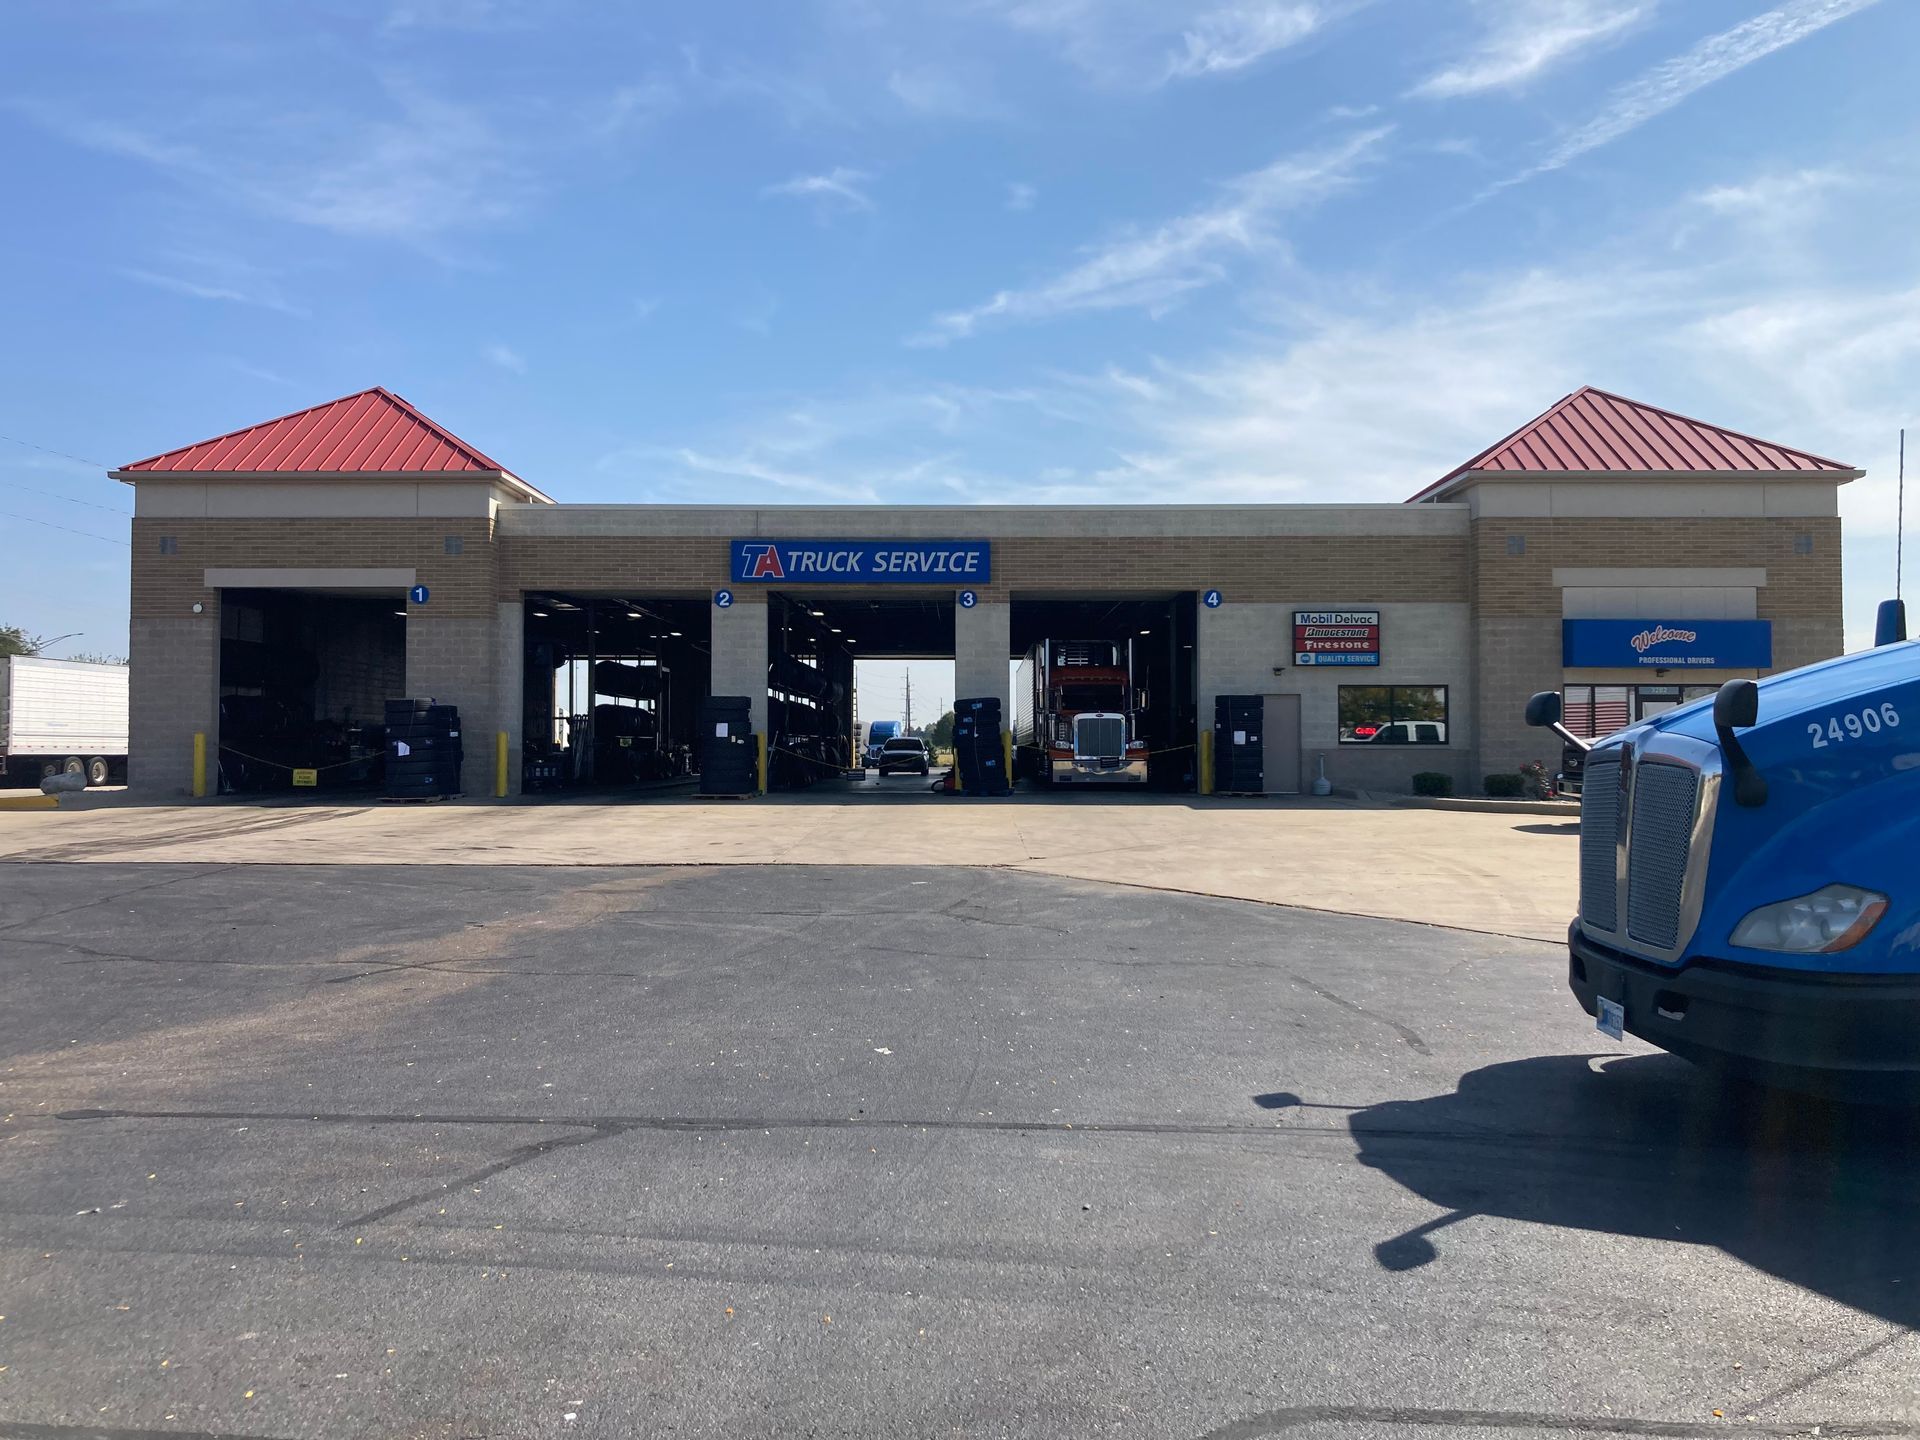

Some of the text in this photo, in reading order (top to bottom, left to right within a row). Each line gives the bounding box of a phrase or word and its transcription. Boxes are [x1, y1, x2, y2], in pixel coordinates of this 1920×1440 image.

[742, 545, 979, 578] TA TRUCK SERVICE
[415, 587, 423, 602] 1
[719, 591, 730, 606] 2
[963, 592, 974, 606] 3
[1207, 592, 1219, 606] 4
[1300, 614, 1373, 624] Mobil Delvac
[1304, 626, 1369, 638] BRIDGESTONE
[1631, 625, 1697, 653] Welcome
[1304, 640, 1370, 651] Firestone
[1318, 655, 1346, 663] QUALITY
[1347, 655, 1376, 663] SERVICE
[1638, 656, 1686, 664] PROFESSIONAL
[1807, 702, 1900, 749] 24906
